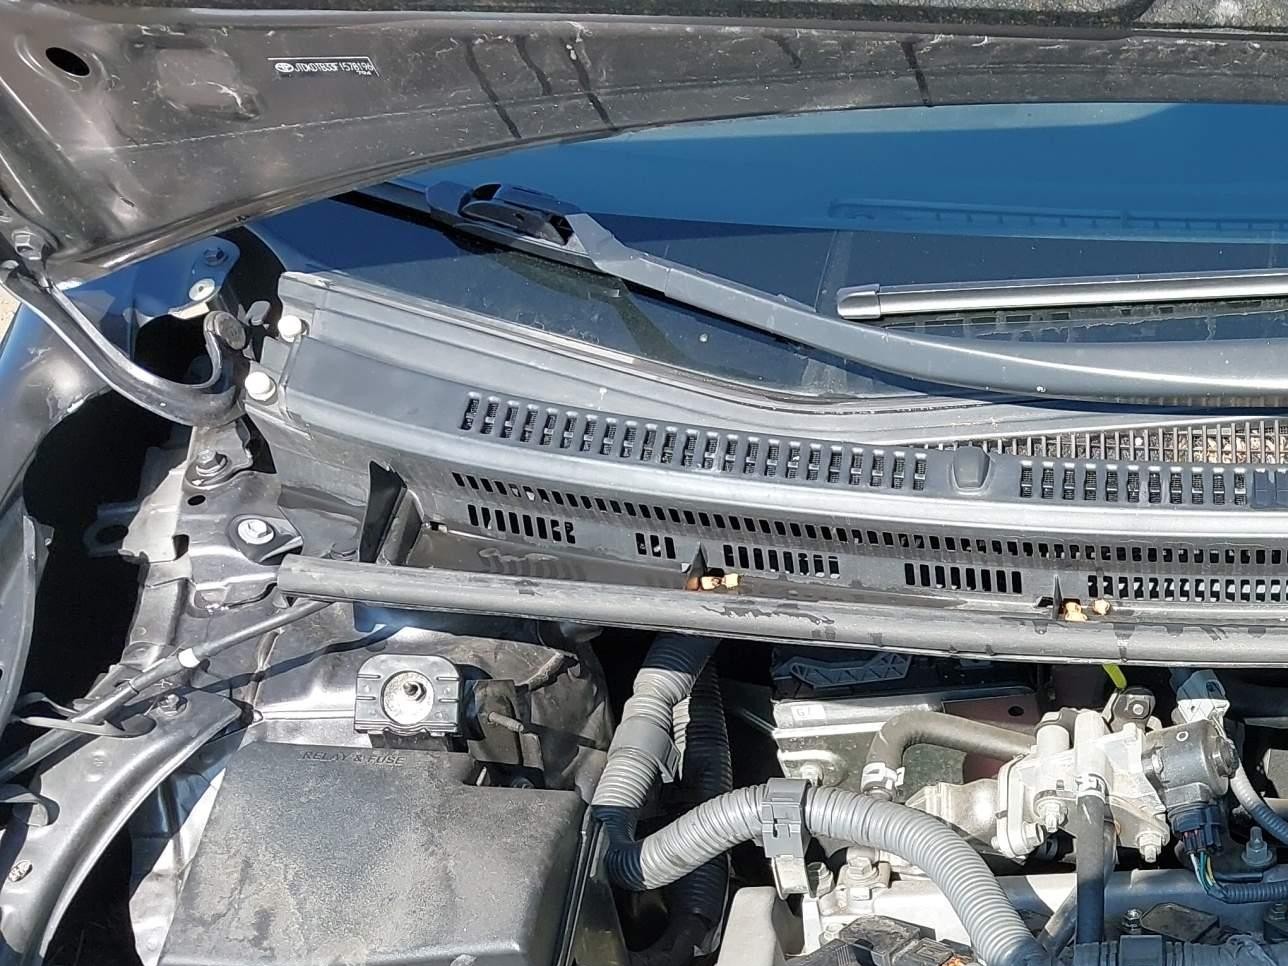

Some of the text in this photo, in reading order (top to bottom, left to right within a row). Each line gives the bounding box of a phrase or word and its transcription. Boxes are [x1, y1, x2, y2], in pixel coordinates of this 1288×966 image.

[302, 751, 405, 765] RELAY & FUSE
